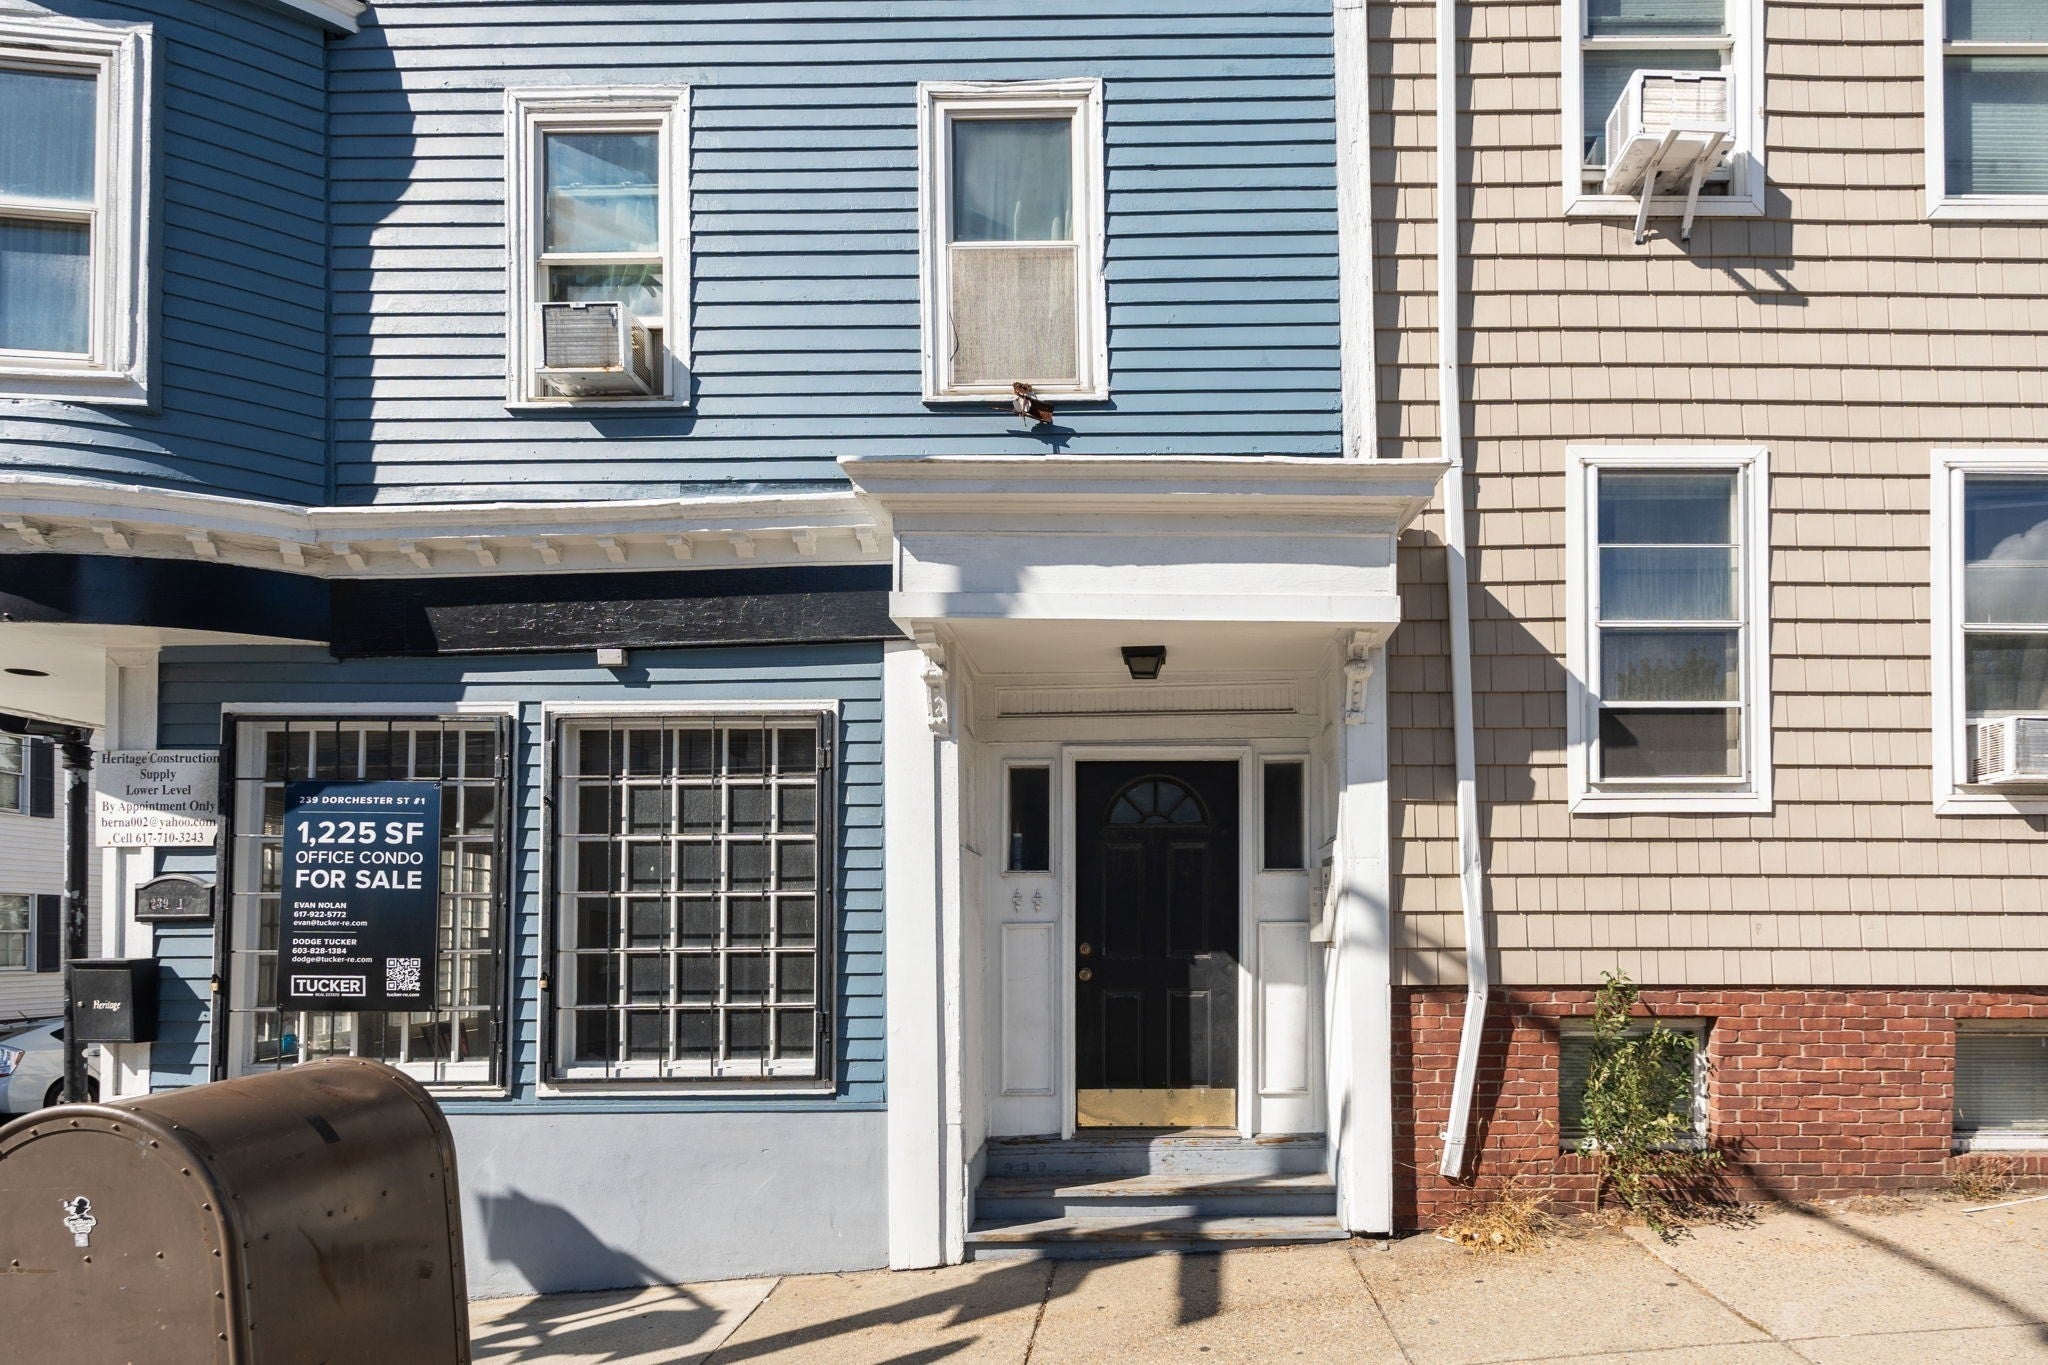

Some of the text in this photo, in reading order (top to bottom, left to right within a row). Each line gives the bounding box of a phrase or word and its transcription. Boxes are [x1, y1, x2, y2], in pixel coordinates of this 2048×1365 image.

[102, 753, 219, 766] Heritage Construction
[140, 769, 176, 781] Supply
[126, 785, 191, 796] Lower Level
[299, 796, 426, 805] 239 DORCHESTER ST #1
[102, 801, 216, 813] By Appointment Only
[101, 817, 216, 829] berna002@yahoo.com
[112, 833, 204, 843] Cell 617-710-3243
[297, 821, 424, 847] 1,225 SF
[295, 850, 424, 865] OFFICE CONDO
[295, 869, 422, 890] FOR SALE
[150, 898, 169, 910] 239
[292, 938, 357, 946] DODGE TUCKER
[291, 956, 373, 964] dodge@tucker-re.com
[296, 979, 361, 992] TUCKER
